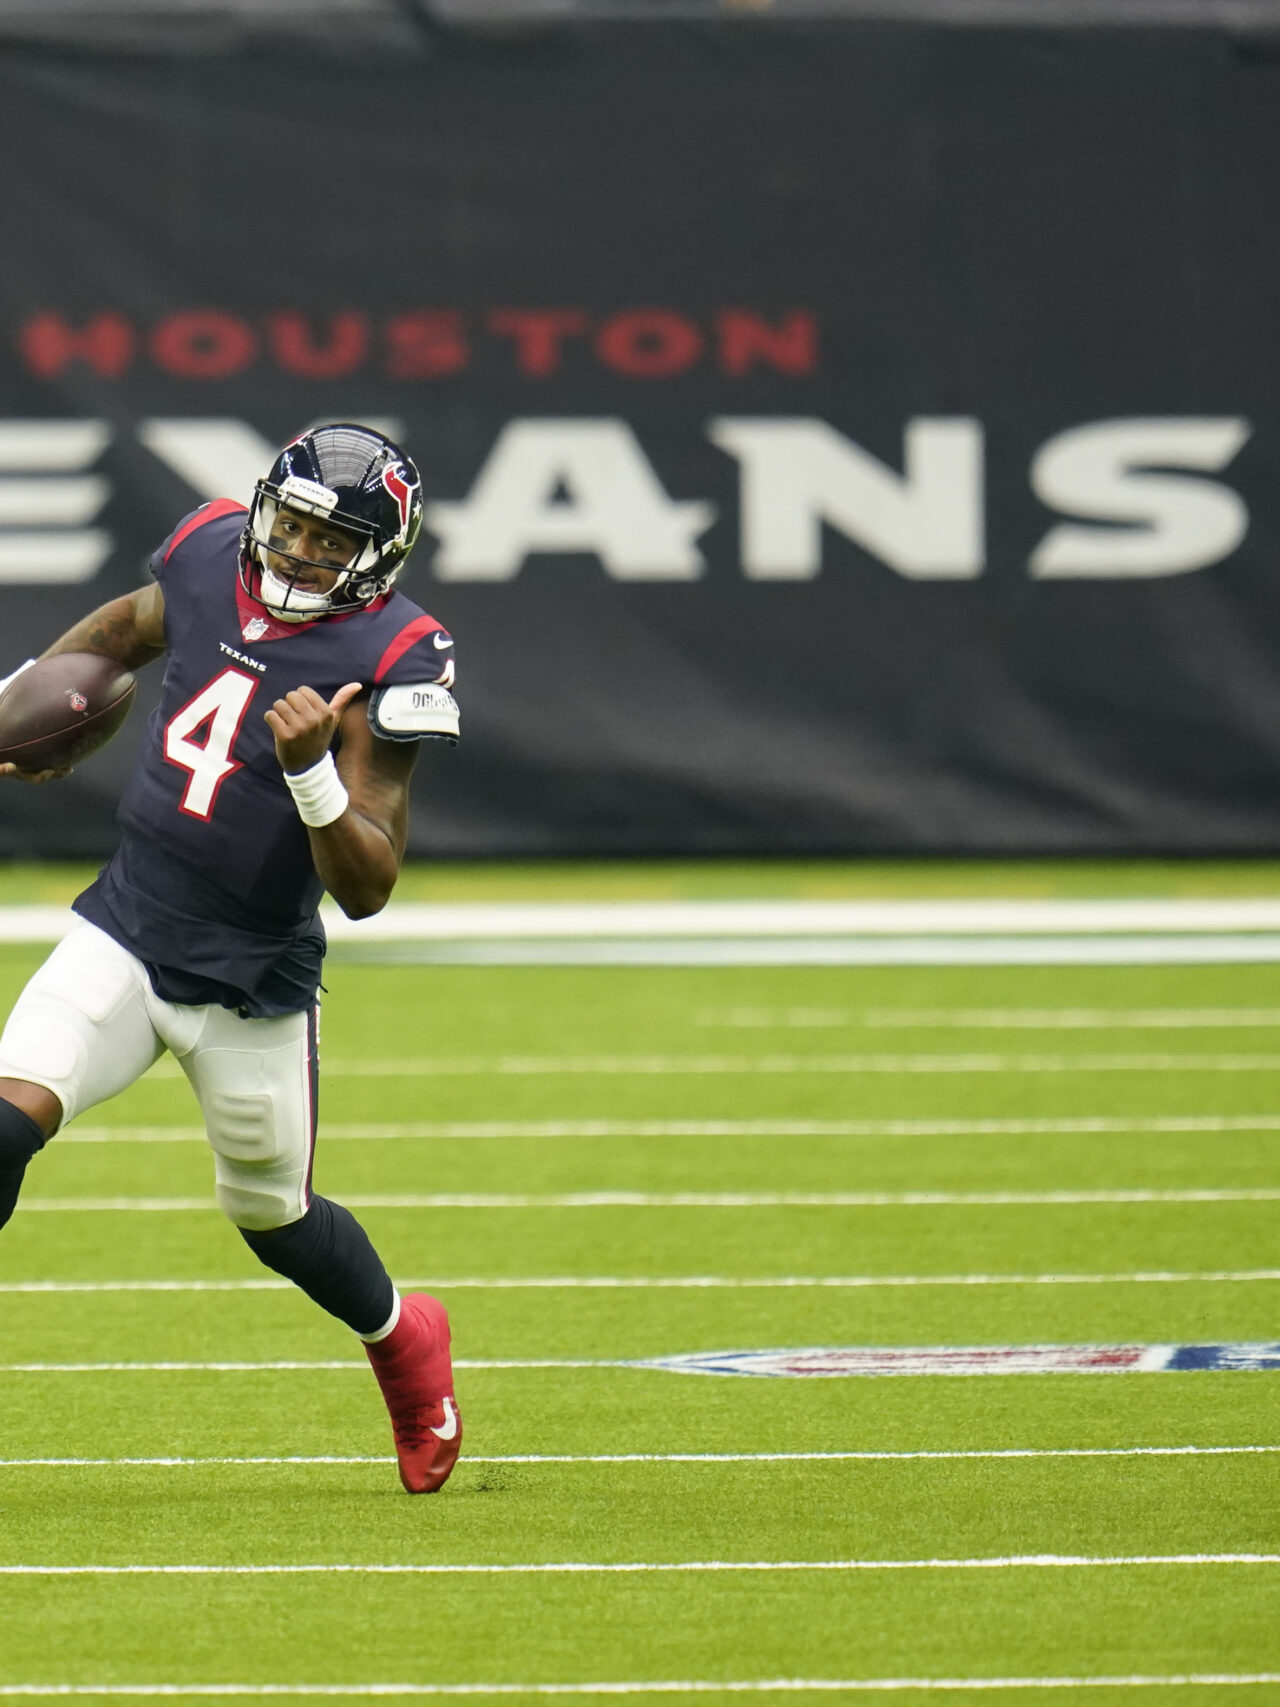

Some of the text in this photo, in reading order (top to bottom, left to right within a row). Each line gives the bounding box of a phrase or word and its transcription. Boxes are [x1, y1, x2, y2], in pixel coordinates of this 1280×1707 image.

[21, 311, 817, 377] HOUSTON
[219, 641, 267, 672] TEXANS
[163, 664, 260, 823] 4
